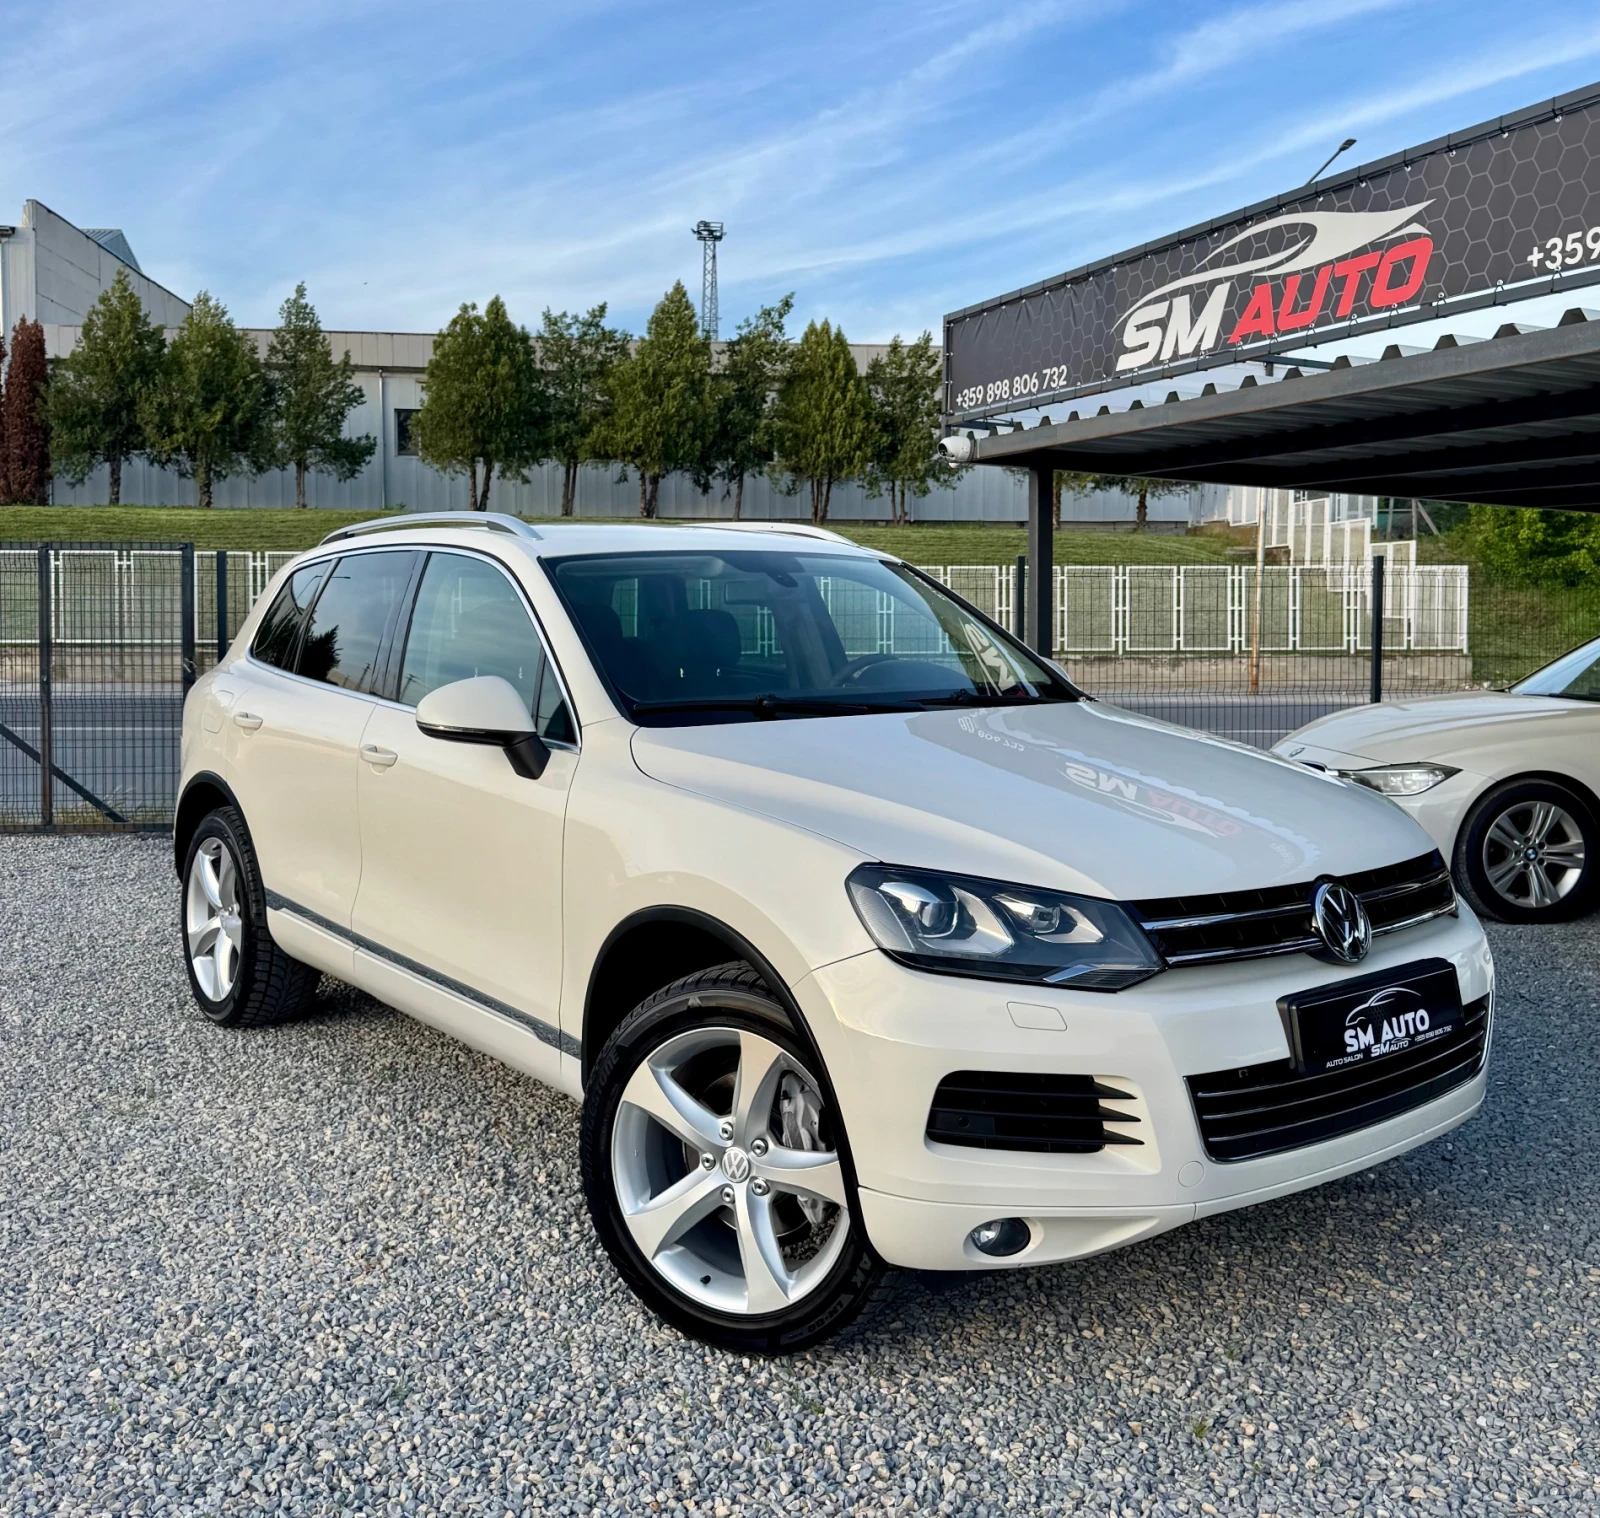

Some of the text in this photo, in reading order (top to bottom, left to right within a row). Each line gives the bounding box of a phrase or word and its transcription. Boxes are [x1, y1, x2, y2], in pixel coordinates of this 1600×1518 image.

[1526, 226, 1600, 271] +359
[1115, 236, 1434, 372] SM AUTO
[955, 364, 1067, 408] +359 898 806 732
[1343, 1008, 1430, 1053] SM AUTO
[1370, 1040, 1409, 1057] SM AUTO
[1326, 1052, 1363, 1068] AUTO SALON
